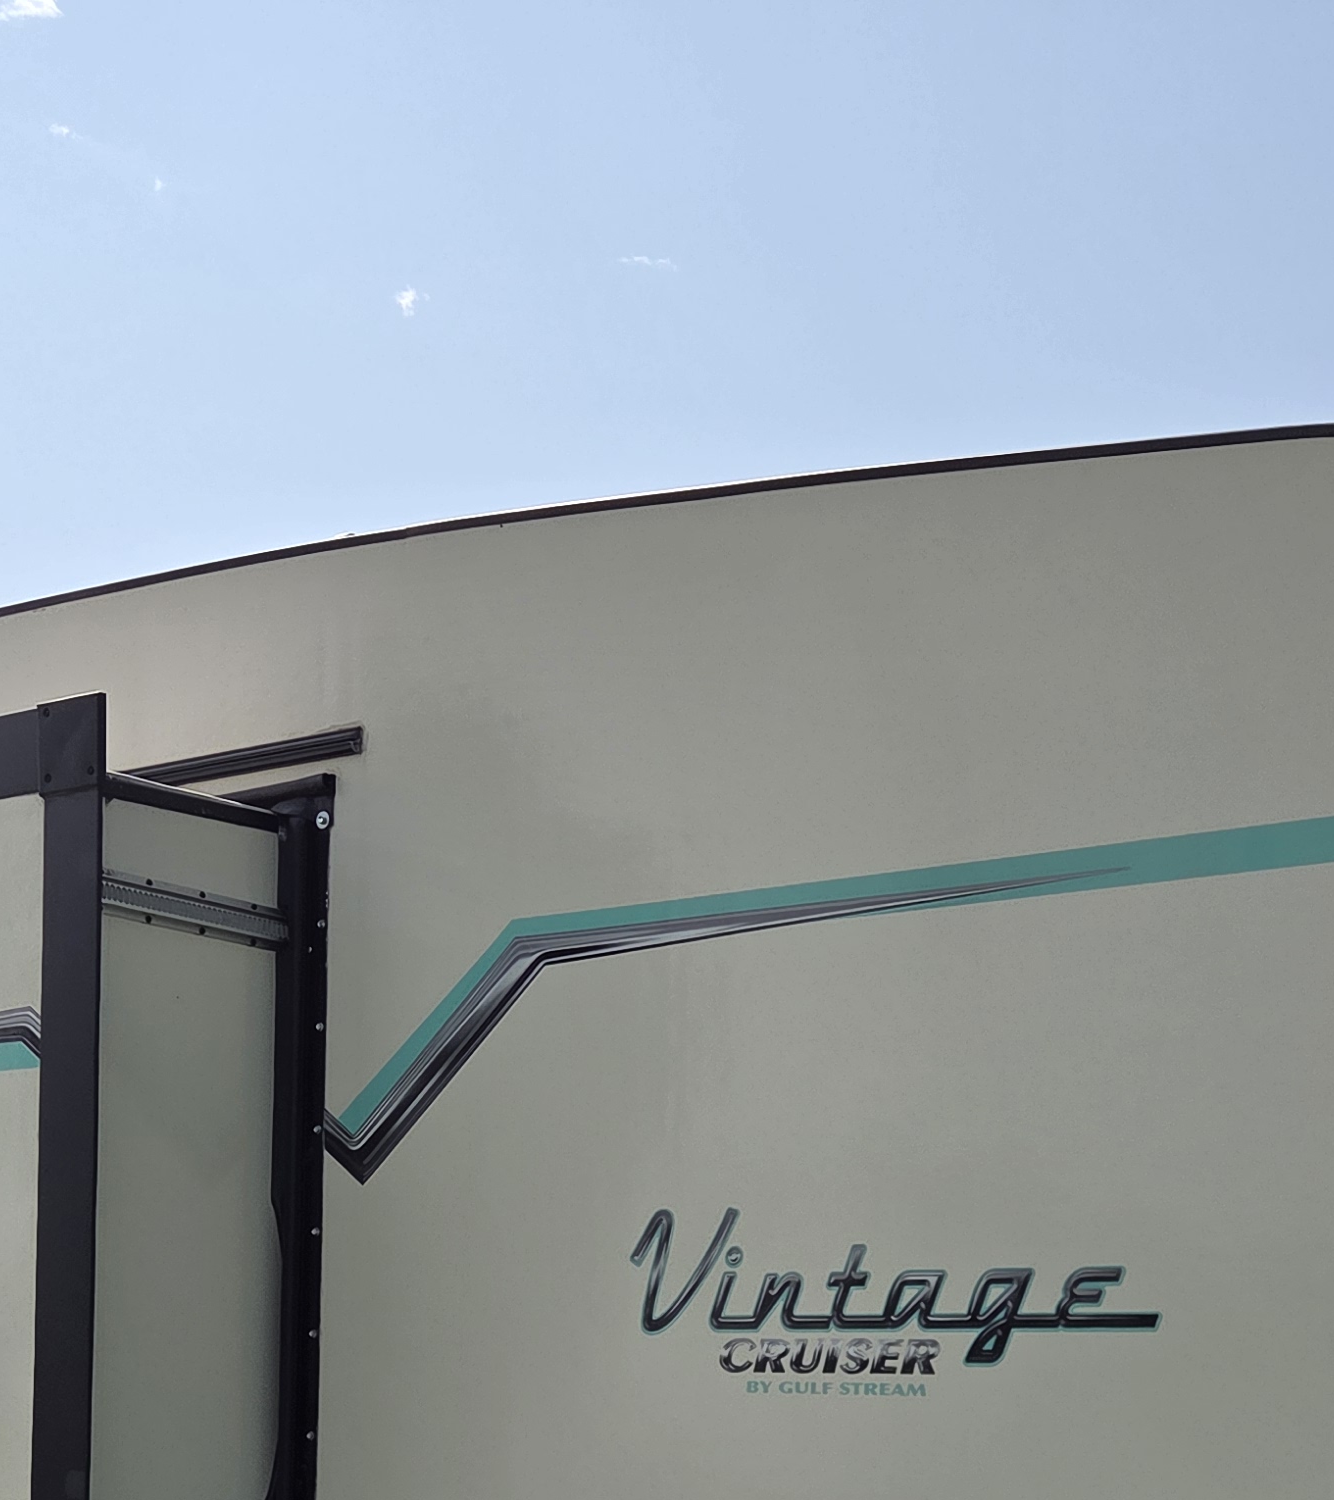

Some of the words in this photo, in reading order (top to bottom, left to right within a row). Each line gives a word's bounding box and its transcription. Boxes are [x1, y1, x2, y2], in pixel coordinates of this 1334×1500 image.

[629, 1207, 1161, 1367] Vintage
[719, 1337, 940, 1375] CRUISER
[746, 1380, 771, 1394] BY
[778, 1381, 833, 1395] GULF
[839, 1382, 927, 1397] STREAM
